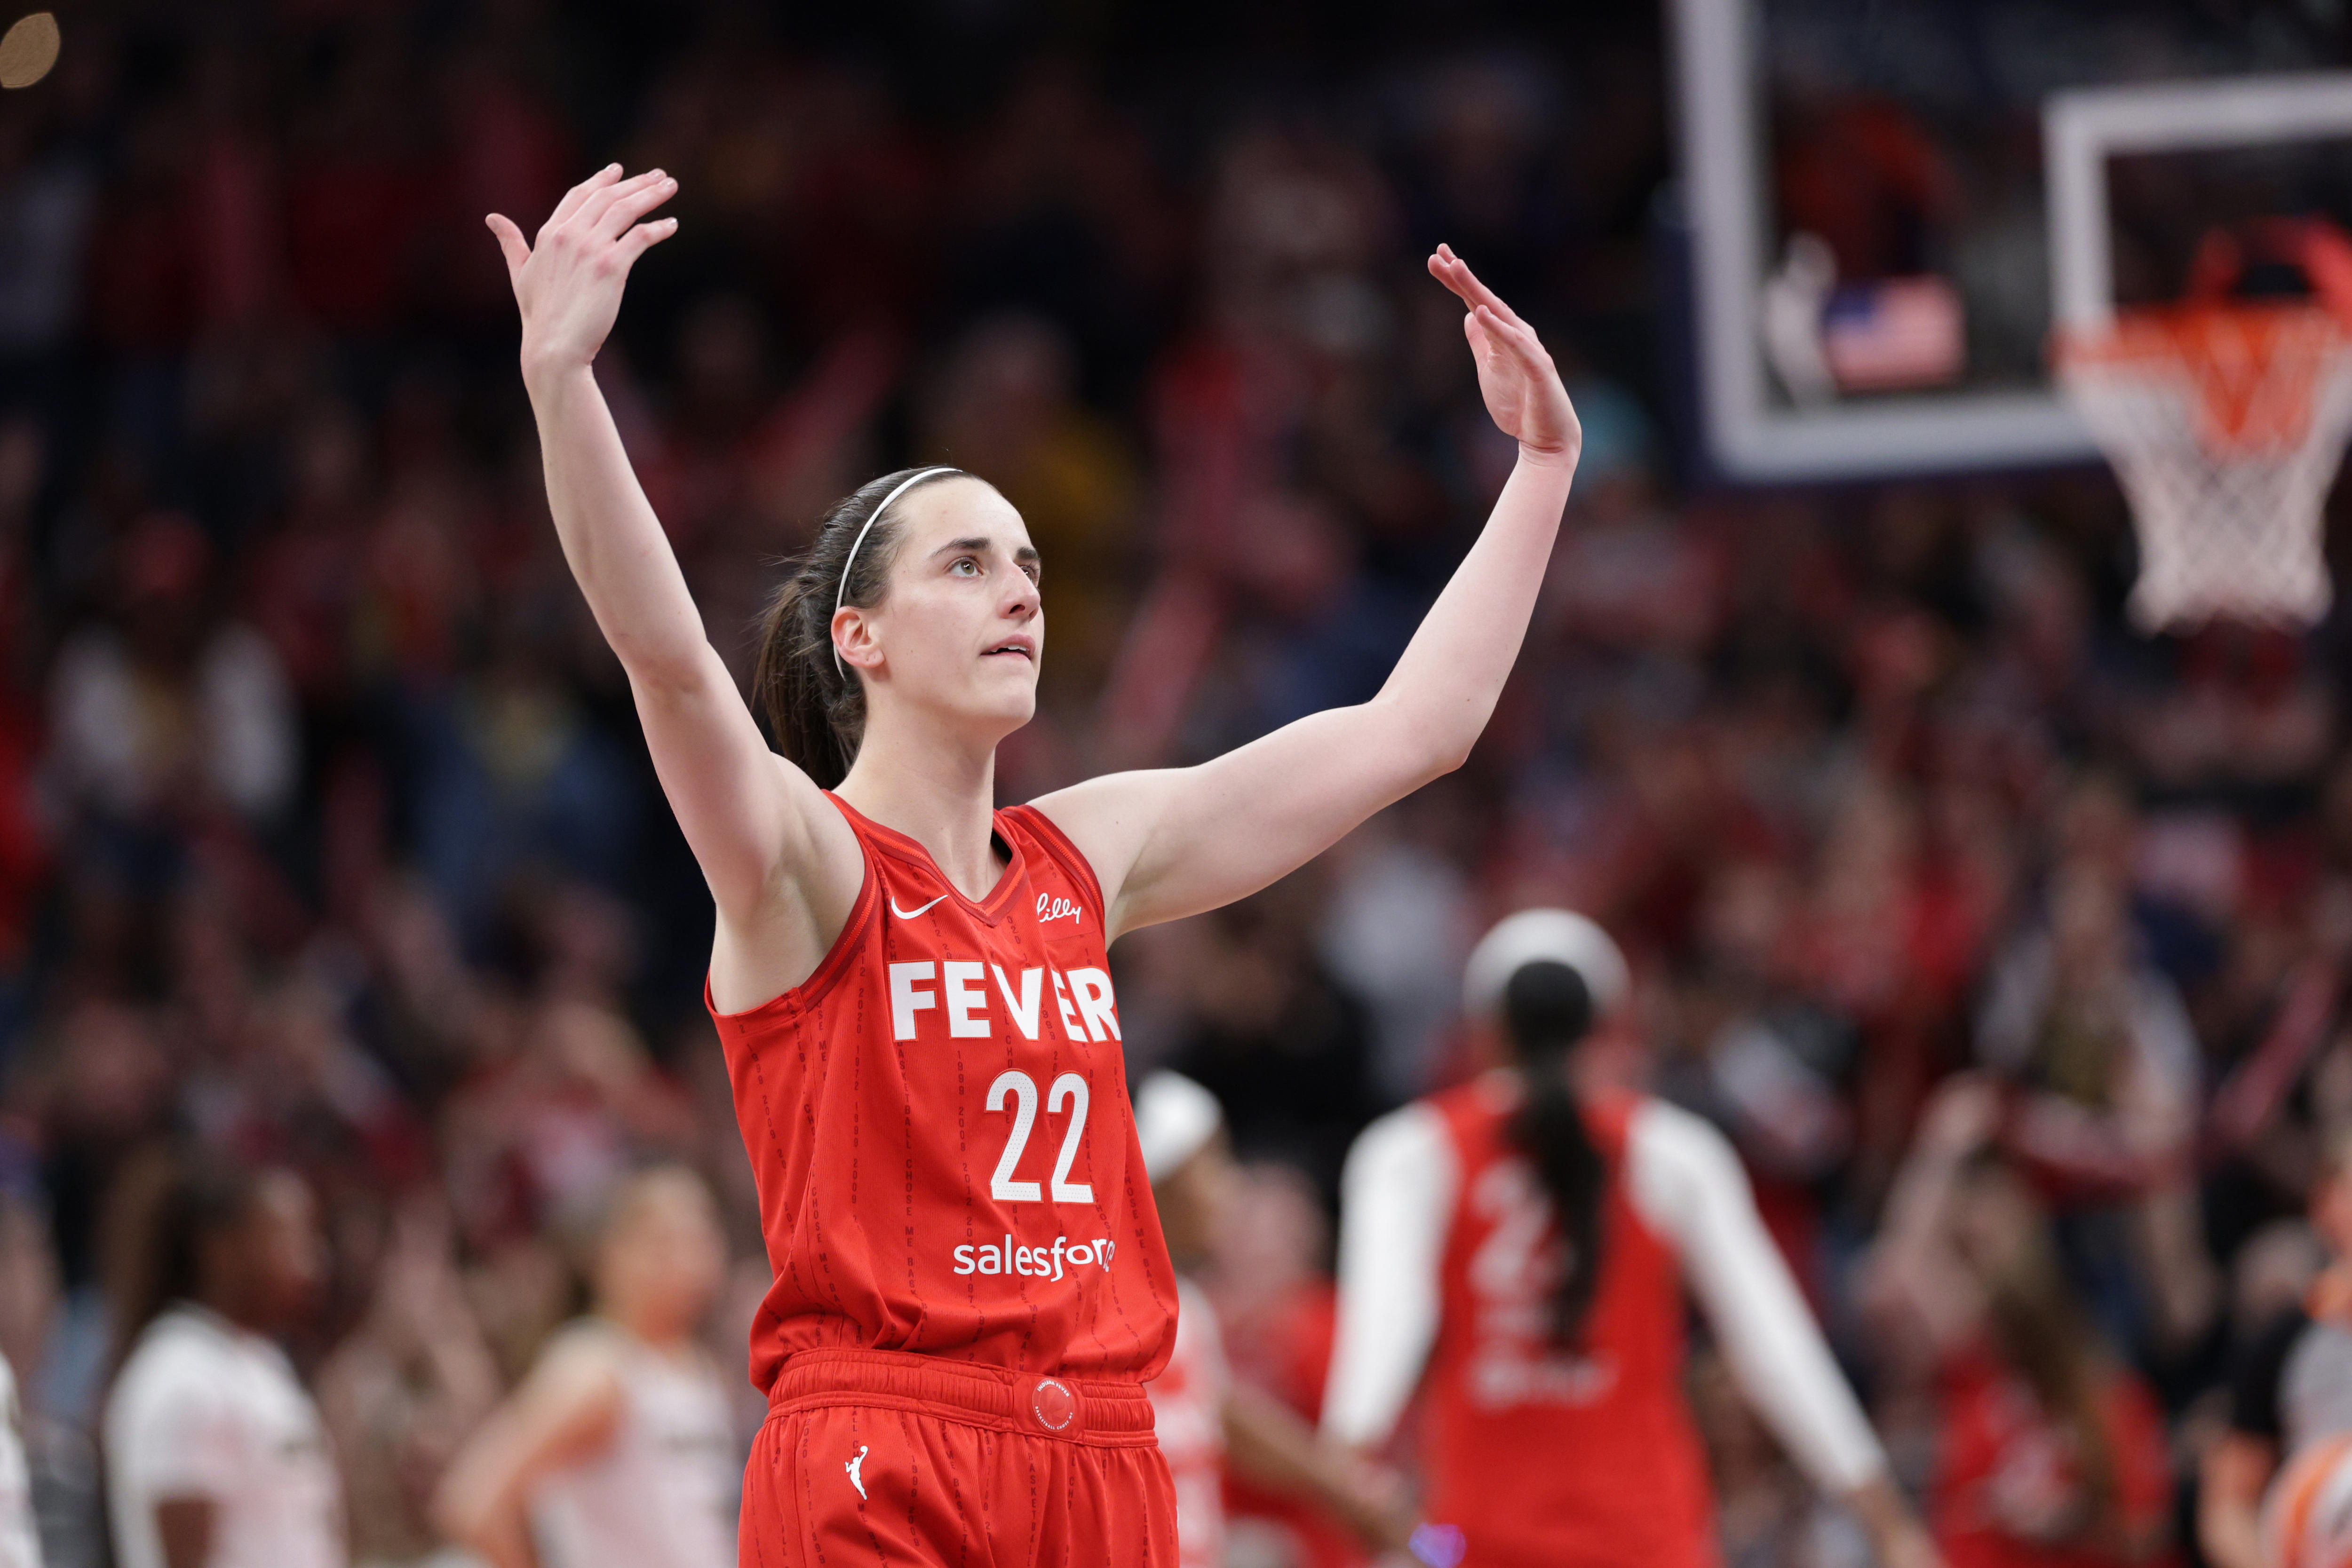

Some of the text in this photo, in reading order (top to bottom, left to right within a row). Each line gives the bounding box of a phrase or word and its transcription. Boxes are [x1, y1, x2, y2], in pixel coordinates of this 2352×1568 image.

[887, 958, 1122, 1044] FEVER
[762, 1094, 777, 1140] 2009
[984, 1068, 1097, 1204] 22
[962, 1163, 972, 1206] 2012
[812, 1187, 830, 1275] CHOSE ME
[905, 1226, 913, 1248] ME
[1135, 1228, 1145, 1249] ME
[1036, 1379, 1071, 1398] INDIANA FEVER
[802, 1418, 811, 1458] 2020
[1034, 1406, 1074, 1430] BASKETBALL CHOSE ME
[1028, 1453, 1037, 1567] BASKETBALL
